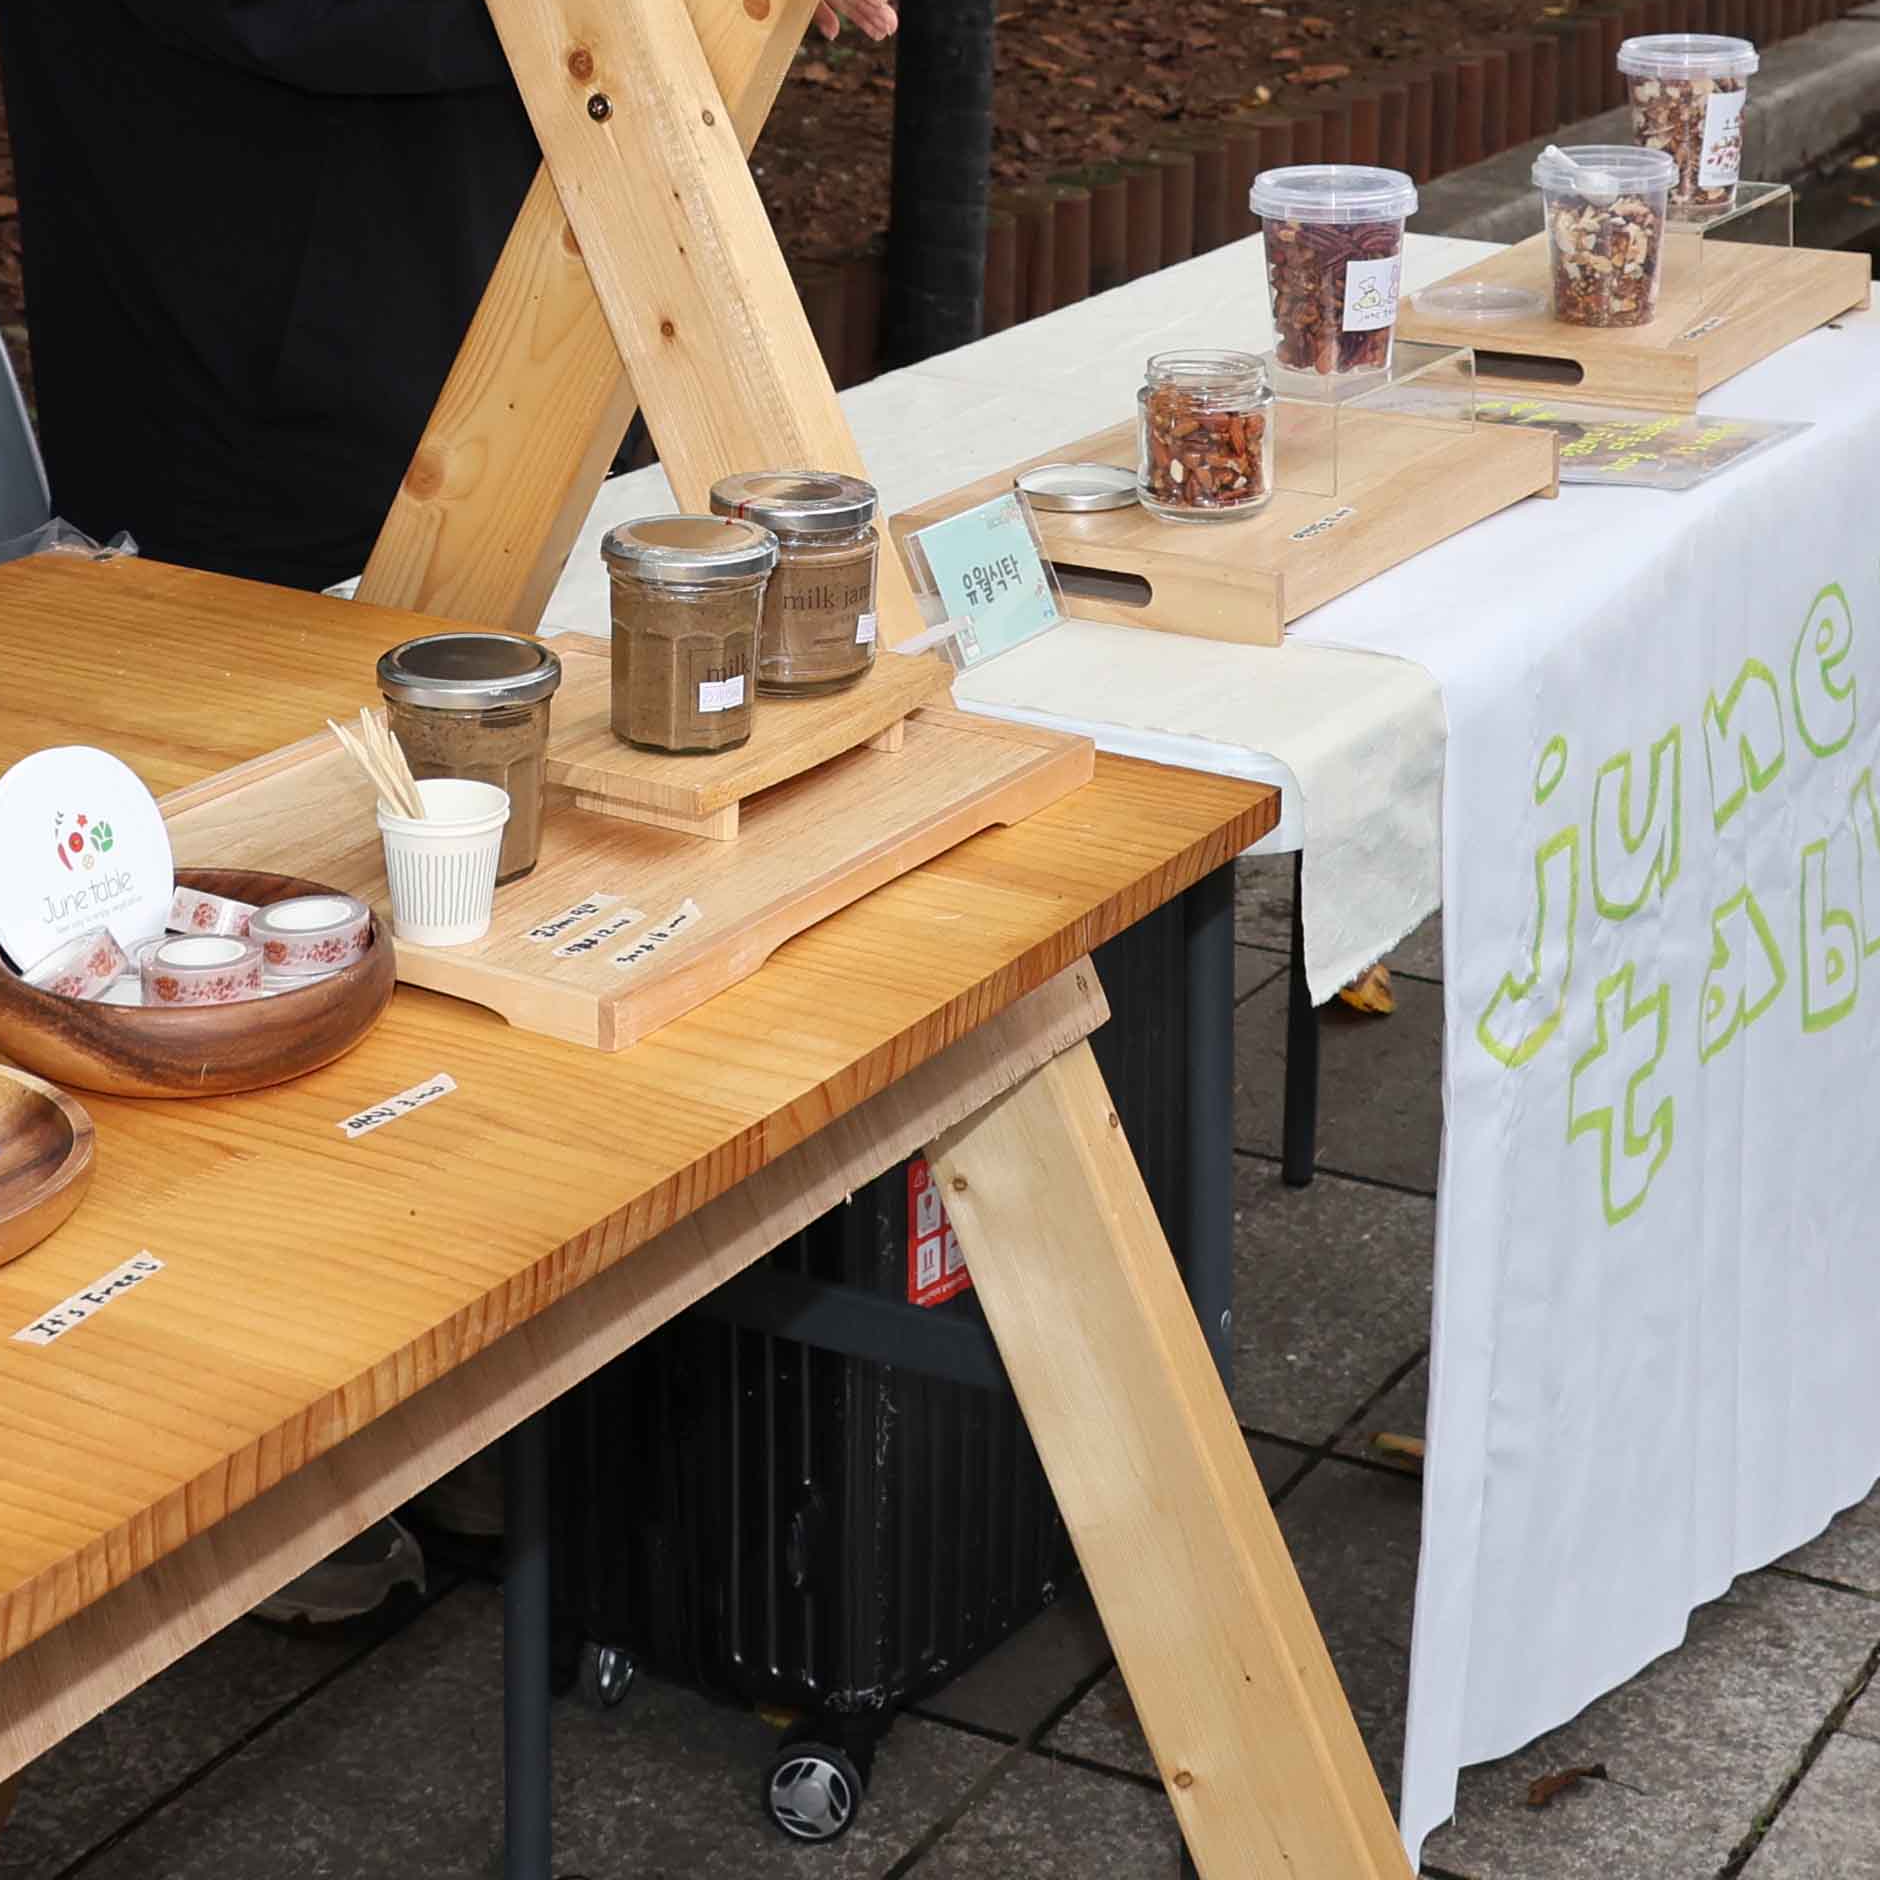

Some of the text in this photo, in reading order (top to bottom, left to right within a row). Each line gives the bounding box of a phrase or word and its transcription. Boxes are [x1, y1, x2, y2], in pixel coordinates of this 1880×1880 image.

[783, 585, 835, 610] milk
[962, 553, 1023, 608] 유월식탁
[707, 652, 752, 682] milk
[1476, 580, 1859, 1068] june
